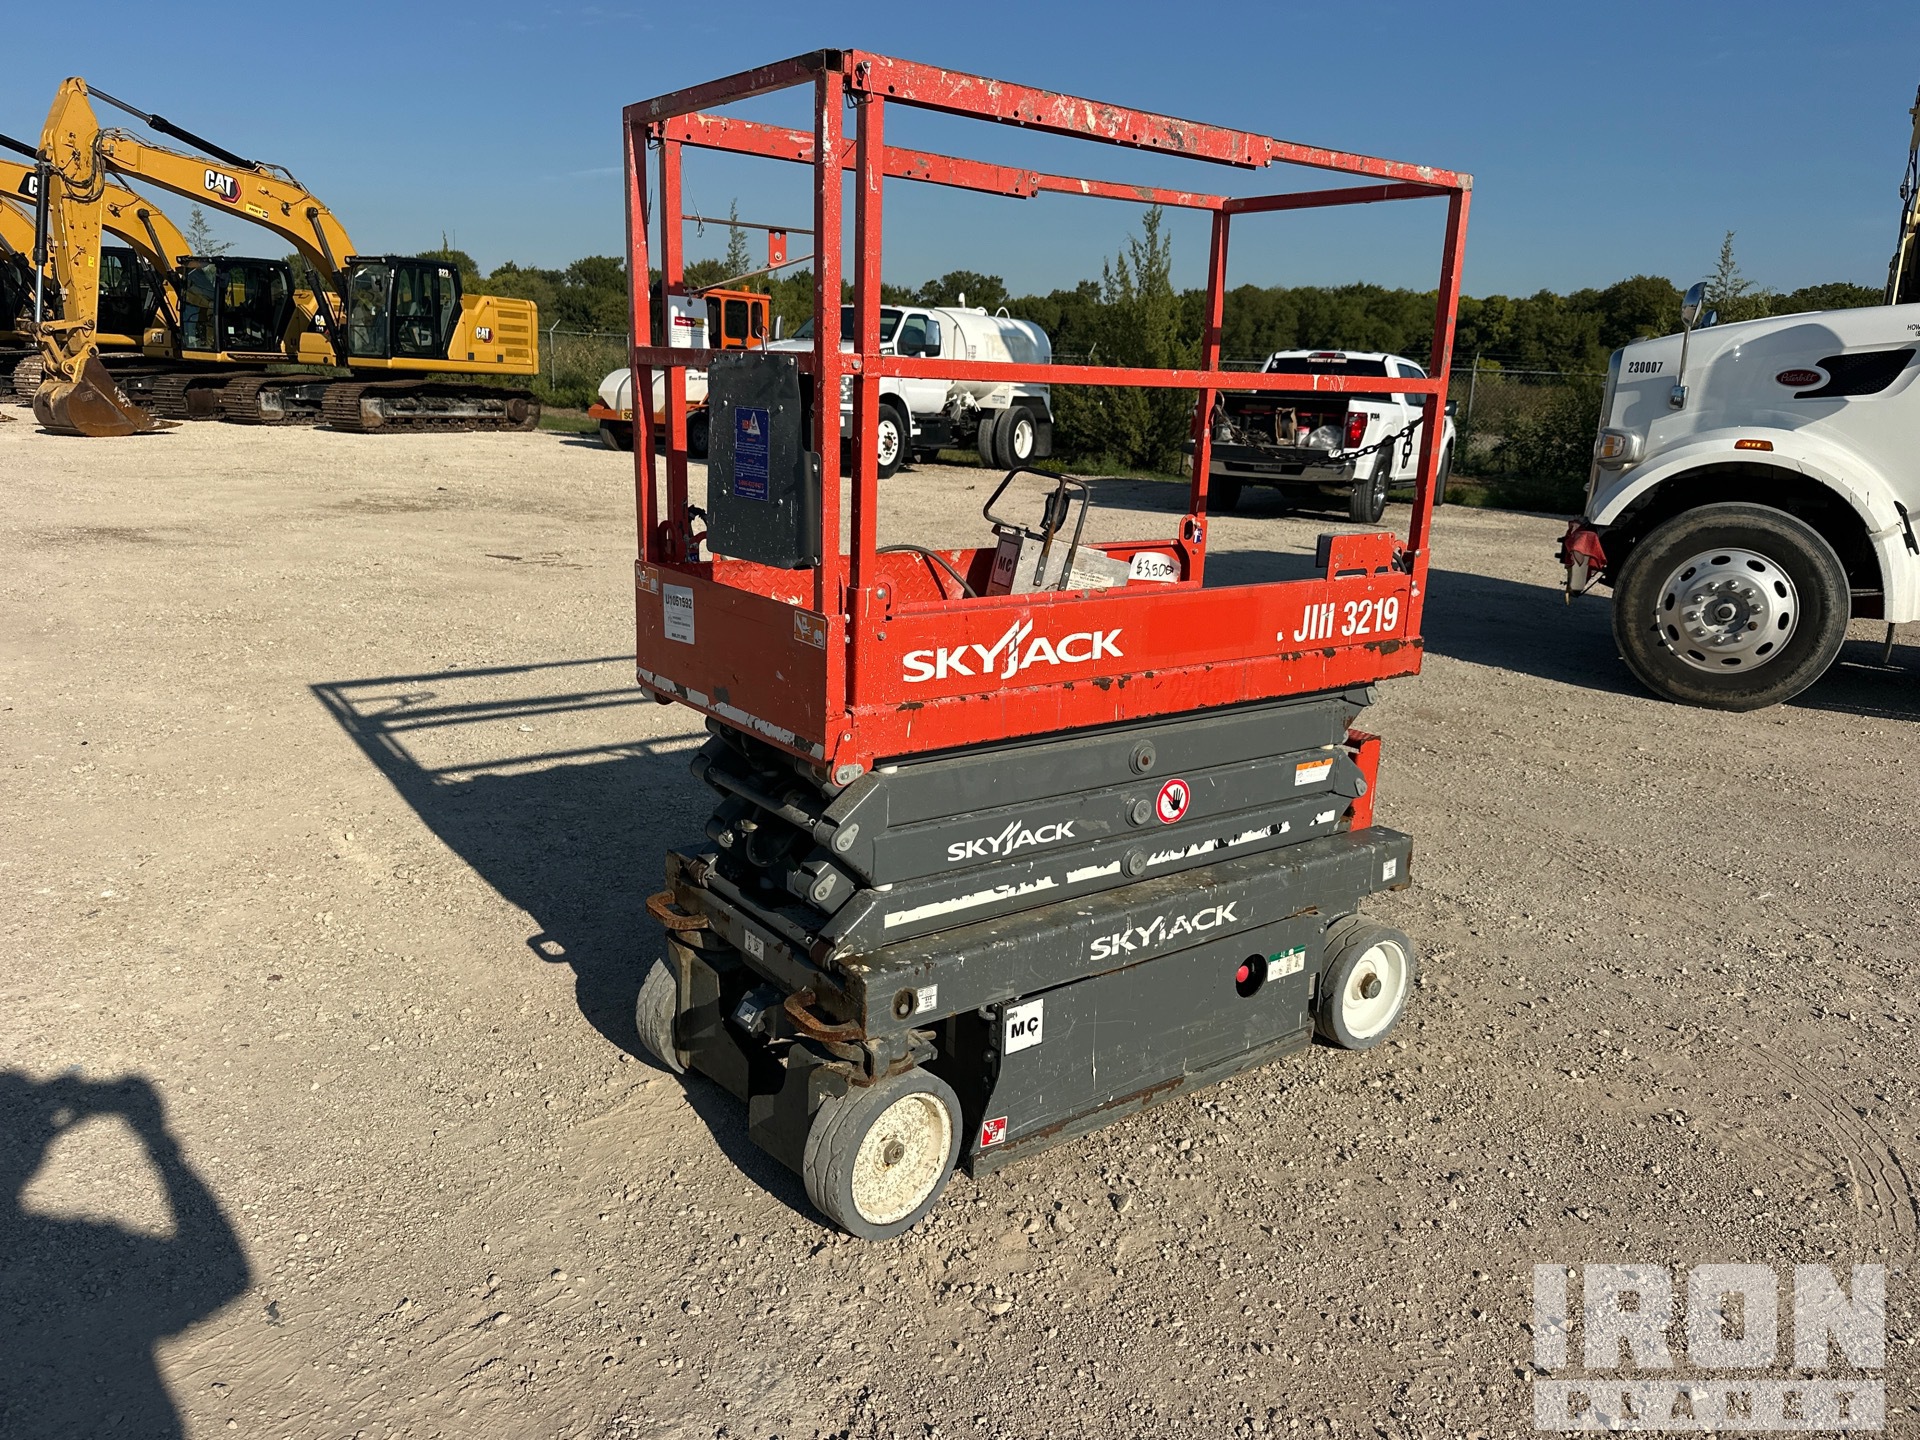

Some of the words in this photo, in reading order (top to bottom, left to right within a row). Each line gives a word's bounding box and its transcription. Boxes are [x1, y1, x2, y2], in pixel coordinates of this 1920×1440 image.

[205, 169, 233, 197] CAT
[476, 327, 490, 341] CAT
[1628, 361, 1664, 373] 230007
[1781, 374, 1816, 382] Peterbilt
[998, 556, 1013, 573] MC
[1341, 596, 1399, 636] 3219
[903, 618, 1124, 682] SKYJACK
[947, 819, 1076, 862] SKYJACK
[1090, 901, 1238, 961] SKYJACK
